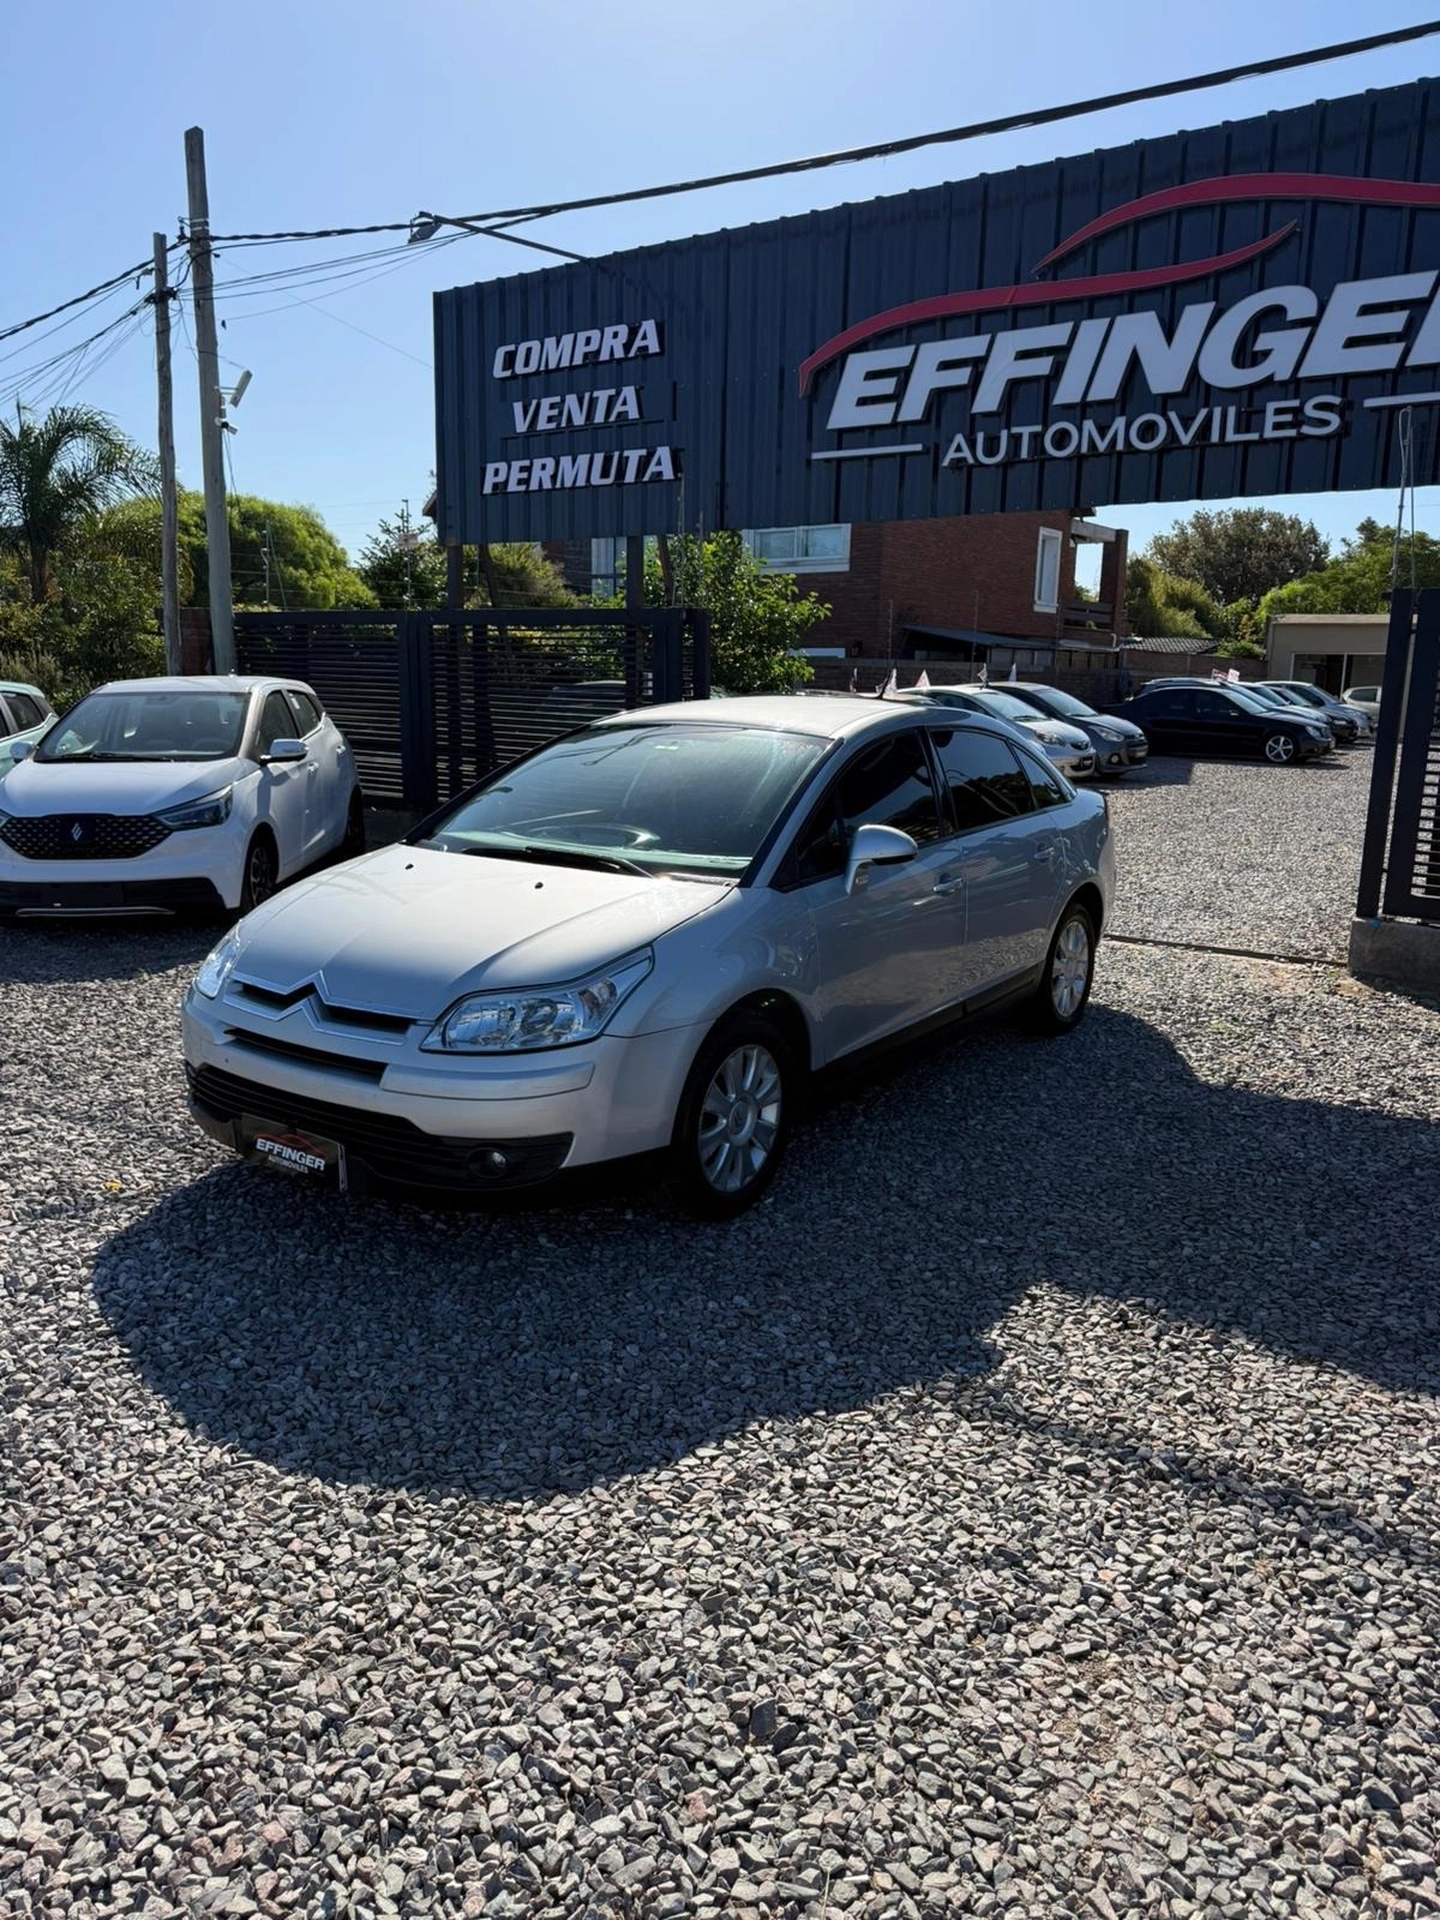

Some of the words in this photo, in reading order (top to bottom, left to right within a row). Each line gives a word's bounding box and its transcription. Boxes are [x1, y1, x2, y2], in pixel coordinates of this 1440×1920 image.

[493, 319, 660, 379] COMPRA
[513, 385, 640, 434] VENTA
[941, 395, 1342, 469] AUTOMOVILES
[483, 446, 675, 495] PERMUTA
[256, 1138, 325, 1171] EFFINGER
